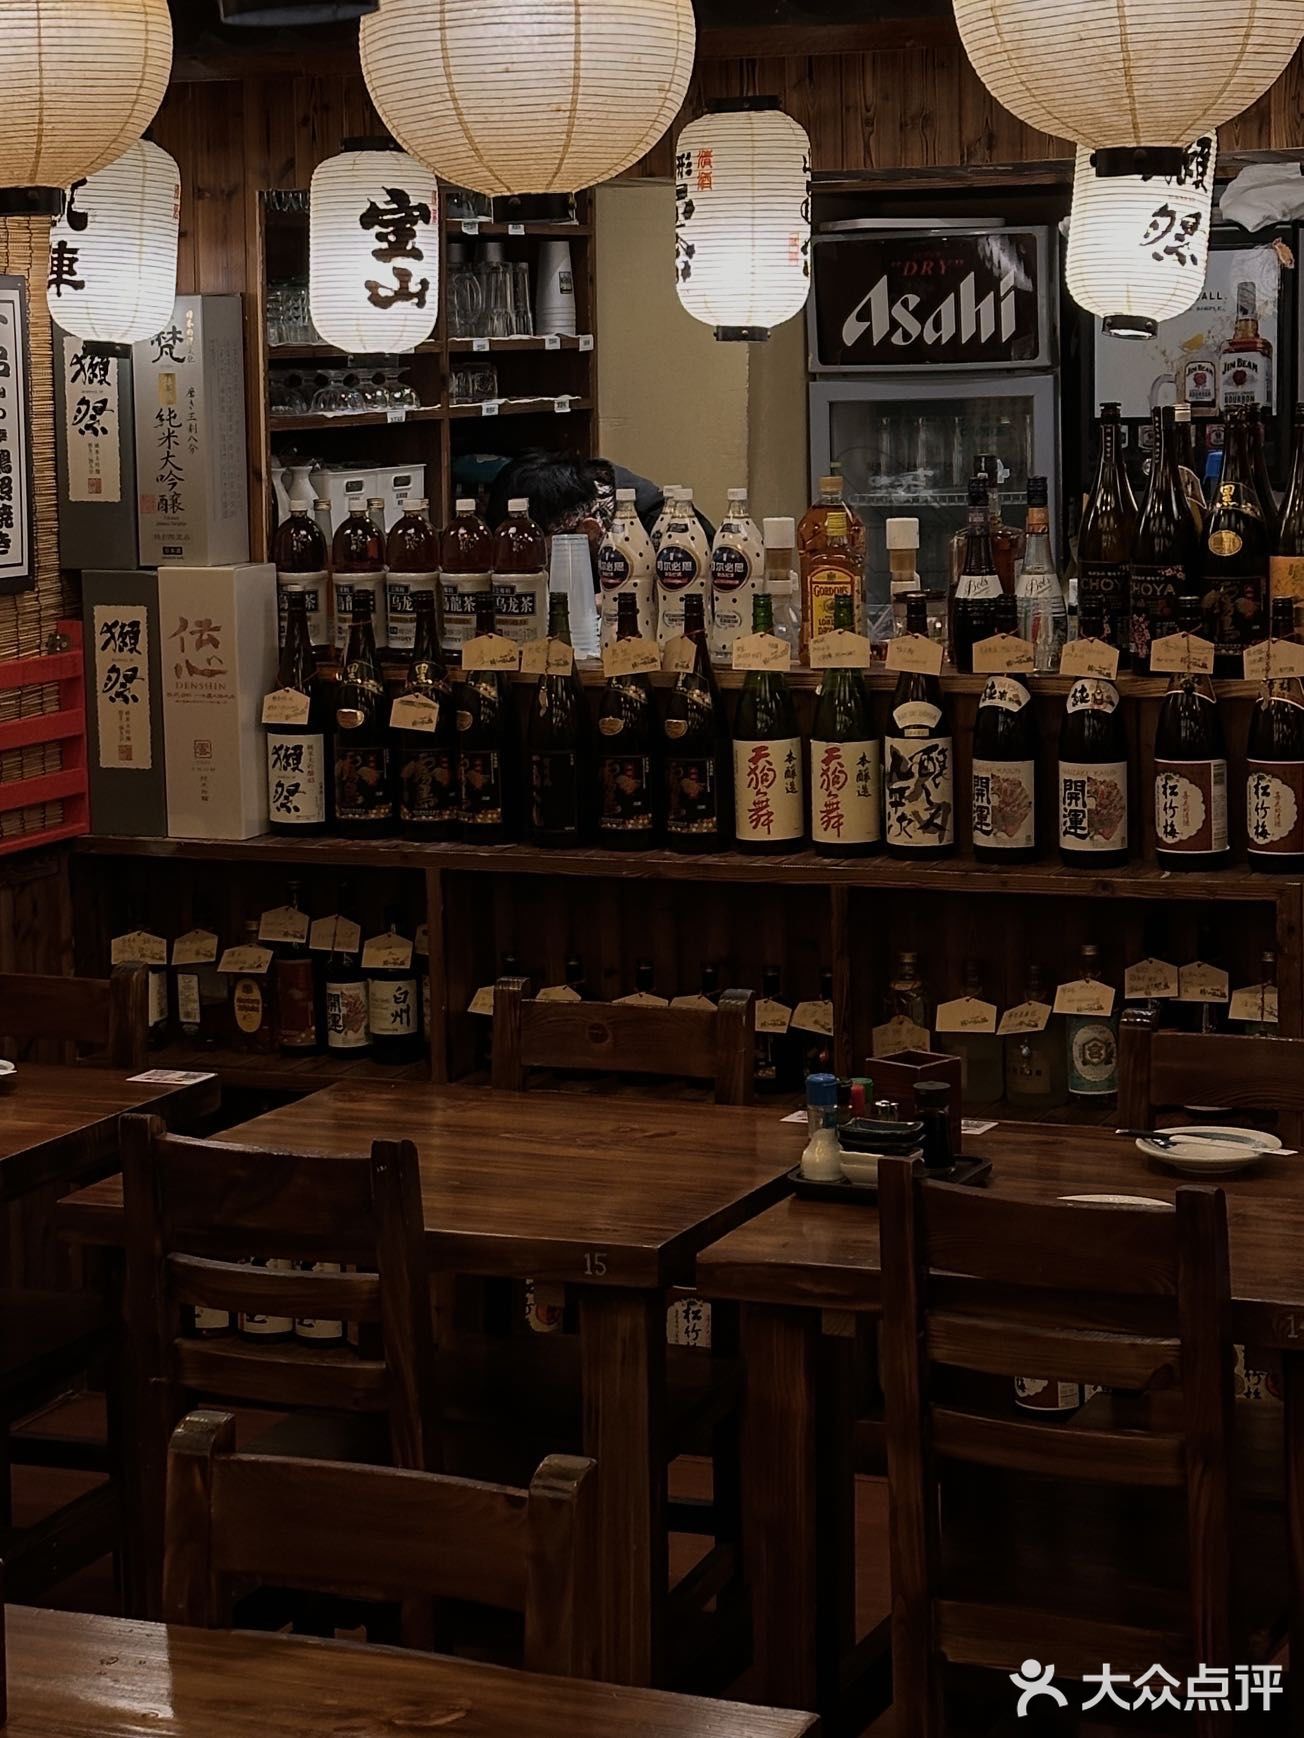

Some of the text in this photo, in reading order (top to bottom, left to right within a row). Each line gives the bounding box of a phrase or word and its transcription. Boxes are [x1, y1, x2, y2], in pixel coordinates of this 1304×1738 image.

[843, 271, 1017, 347] Asahi
[1222, 357, 1259, 375] JIM BEAM
[153, 407, 185, 514] 純米大吟醸
[390, 594, 414, 612] 乌龙
[444, 596, 477, 612] 龍茶
[1081, 577, 1122, 591] CHOY
[1132, 583, 1176, 596] HOYA
[100, 620, 145, 704] 獺祭
[168, 617, 229, 679] 伝心
[175, 681, 227, 691] DENSHIN
[271, 743, 307, 814] 獺祭
[746, 744, 777, 835] 天狗舞
[784, 749, 798, 795] 本醸造
[819, 746, 848, 838] 天狗舞
[855, 751, 872, 798] 本醸造
[973, 775, 994, 836] 開運
[1062, 778, 1091, 840] 開運
[1161, 777, 1179, 839] 松竹梅
[1253, 776, 1271, 839] 松竹梅
[583, 1252, 608, 1277] 15
[682, 1304, 703, 1347] 松竹
